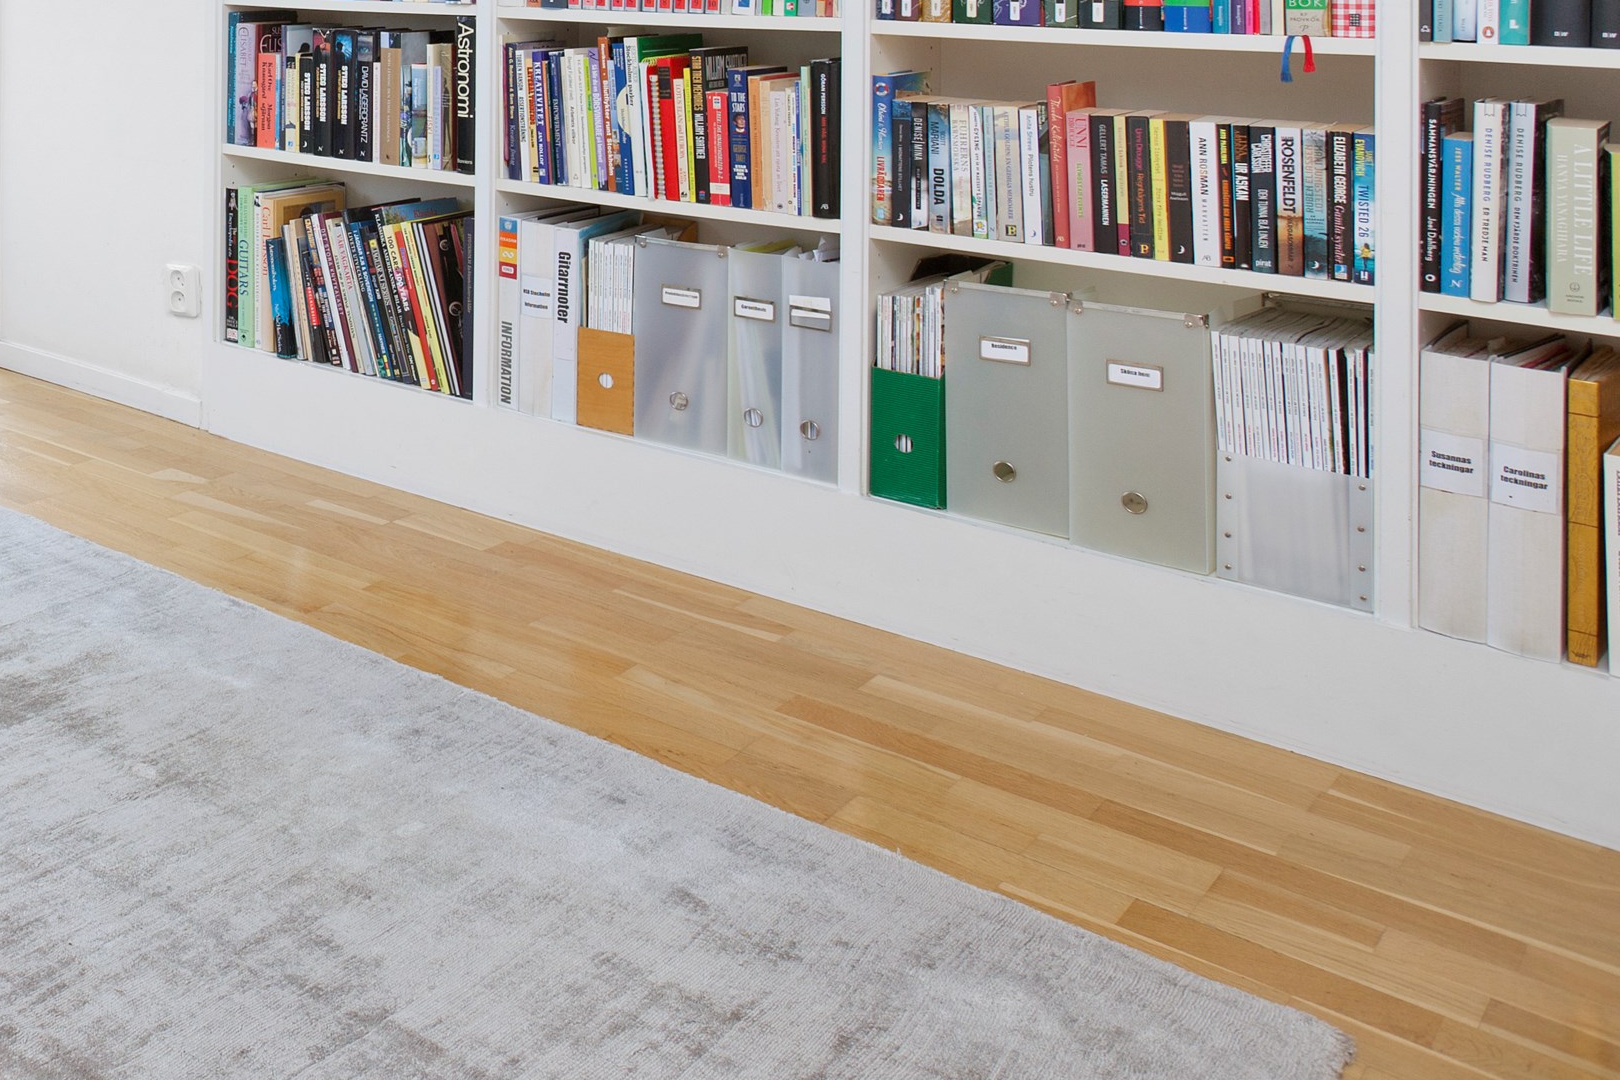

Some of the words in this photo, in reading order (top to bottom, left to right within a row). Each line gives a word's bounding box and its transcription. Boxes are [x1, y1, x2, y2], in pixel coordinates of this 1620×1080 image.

[361, 66, 369, 86] DAVID
[457, 22, 474, 118] Astronomi
[533, 61, 544, 126] KREATIVITET
[694, 113, 705, 135] WILLIAM
[695, 136, 705, 159] SHATNER
[1199, 137, 1207, 155] ANN
[1333, 136, 1345, 174] ELIZABETH
[1483, 128, 1492, 158] DENISE
[1515, 128, 1524, 158] DENISE
[1573, 144, 1592, 154] A
[1200, 158, 1208, 195] ROSMAN
[1235, 163, 1247, 173] UR
[1281, 139, 1296, 214] ROSENFELDT
[1483, 162, 1492, 202] RUDBERG
[1514, 162, 1524, 202] RUDBERG
[933, 168, 944, 205] DOLDA
[1101, 179, 1109, 225] LASERMANNEN
[1236, 175, 1249, 201] ASKAN
[1334, 176, 1345, 203] GEORGE
[1573, 160, 1592, 227] LITTLE
[1357, 185, 1369, 223] TWISTED
[1359, 227, 1370, 237] 26
[240, 240, 249, 296] GUITARS
[1574, 238, 1592, 275] LIFE
[227, 260, 238, 308] DOG
[557, 251, 571, 324] Gitarrnoter
[500, 321, 512, 404] INFORMATION
[991, 343, 1017, 351] Residence
[1429, 459, 1474, 474] teckningar
[1431, 450, 1472, 464] Susannas
[1503, 465, 1546, 480] Carolinas
[1500, 474, 1548, 490] teckningar
